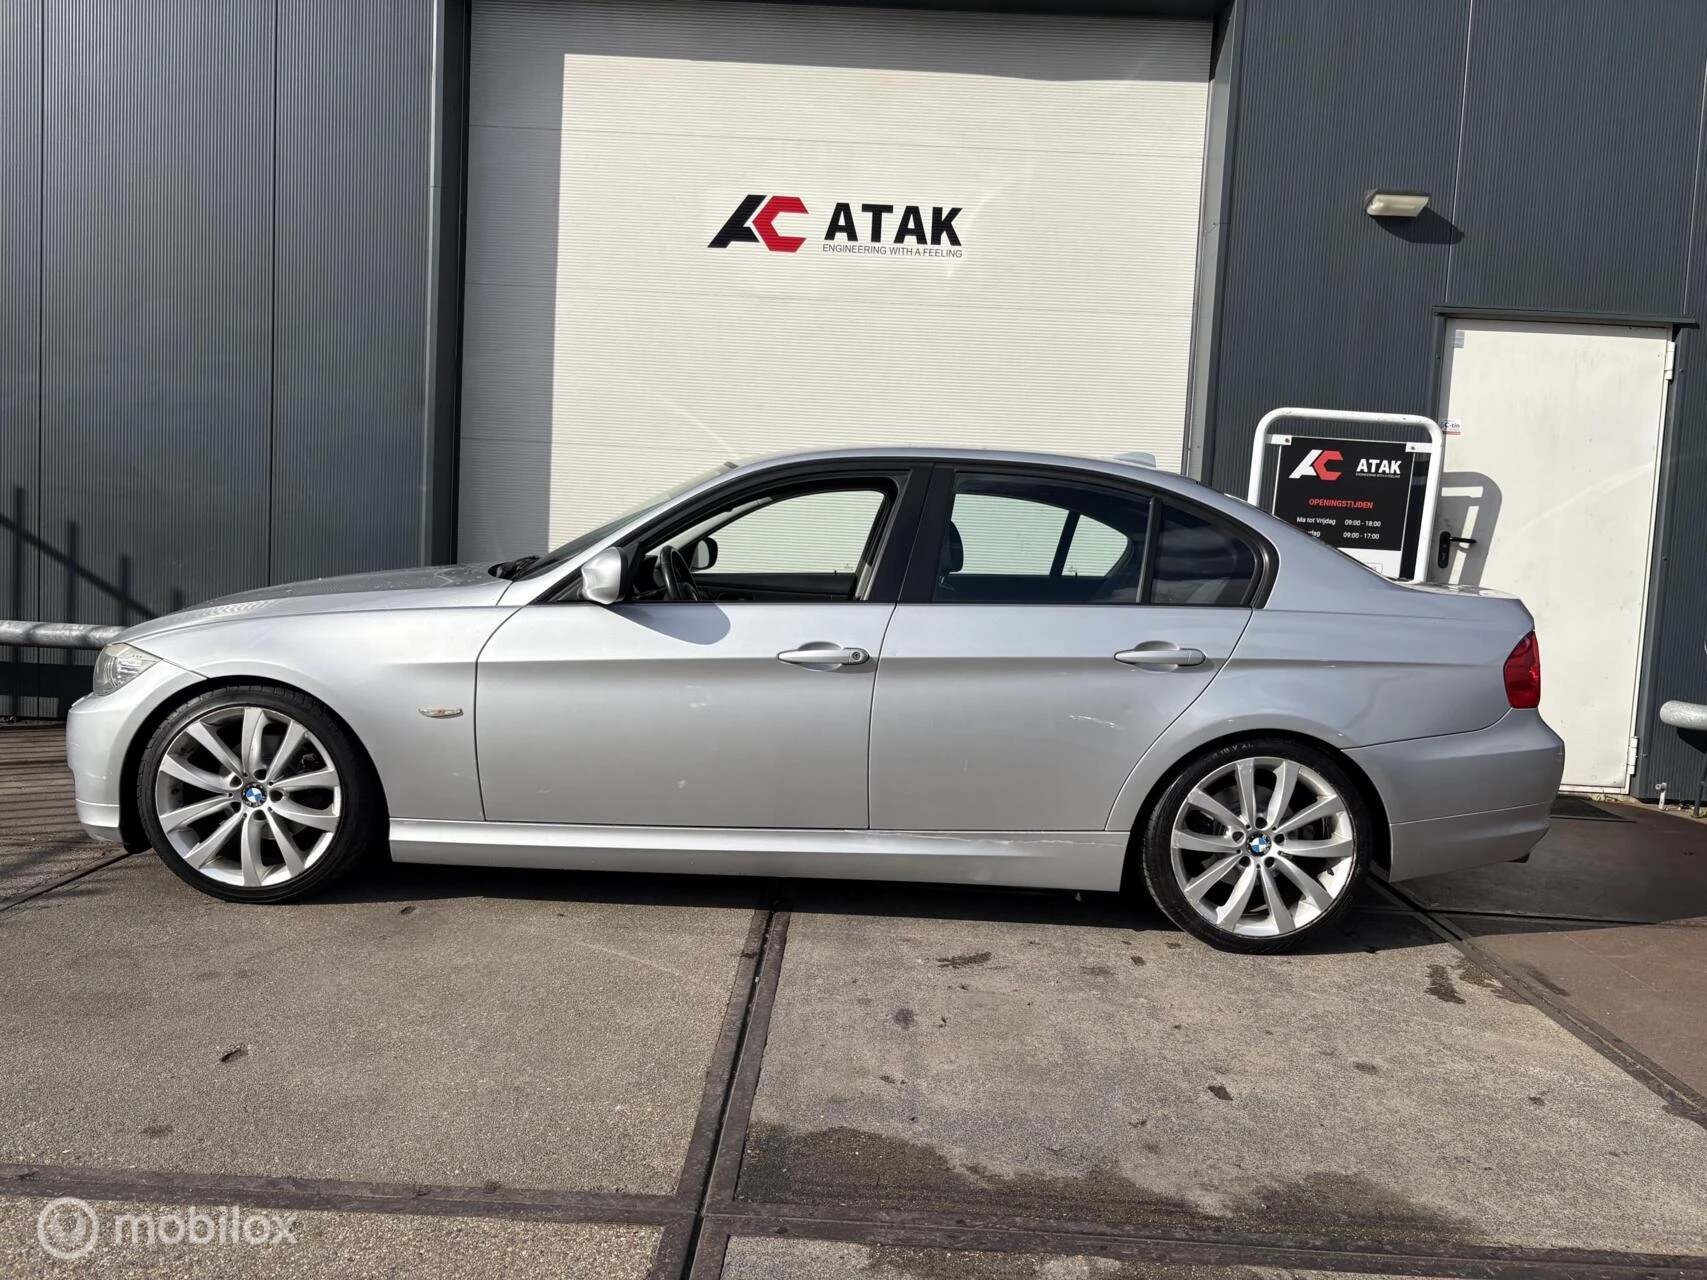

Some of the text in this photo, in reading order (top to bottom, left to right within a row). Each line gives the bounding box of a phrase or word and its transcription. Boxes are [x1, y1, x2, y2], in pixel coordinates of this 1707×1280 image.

[824, 202, 963, 246] ATAK
[822, 243, 963, 258] ENGINEERING WITH A FEELING
[1356, 458, 1402, 474] ATAK
[1308, 498, 1374, 509] OPENINGSTIJDEN
[1315, 517, 1336, 526] Vrijdag
[1342, 531, 1360, 539] 09:00
[1363, 532, 1380, 540] 17:00
